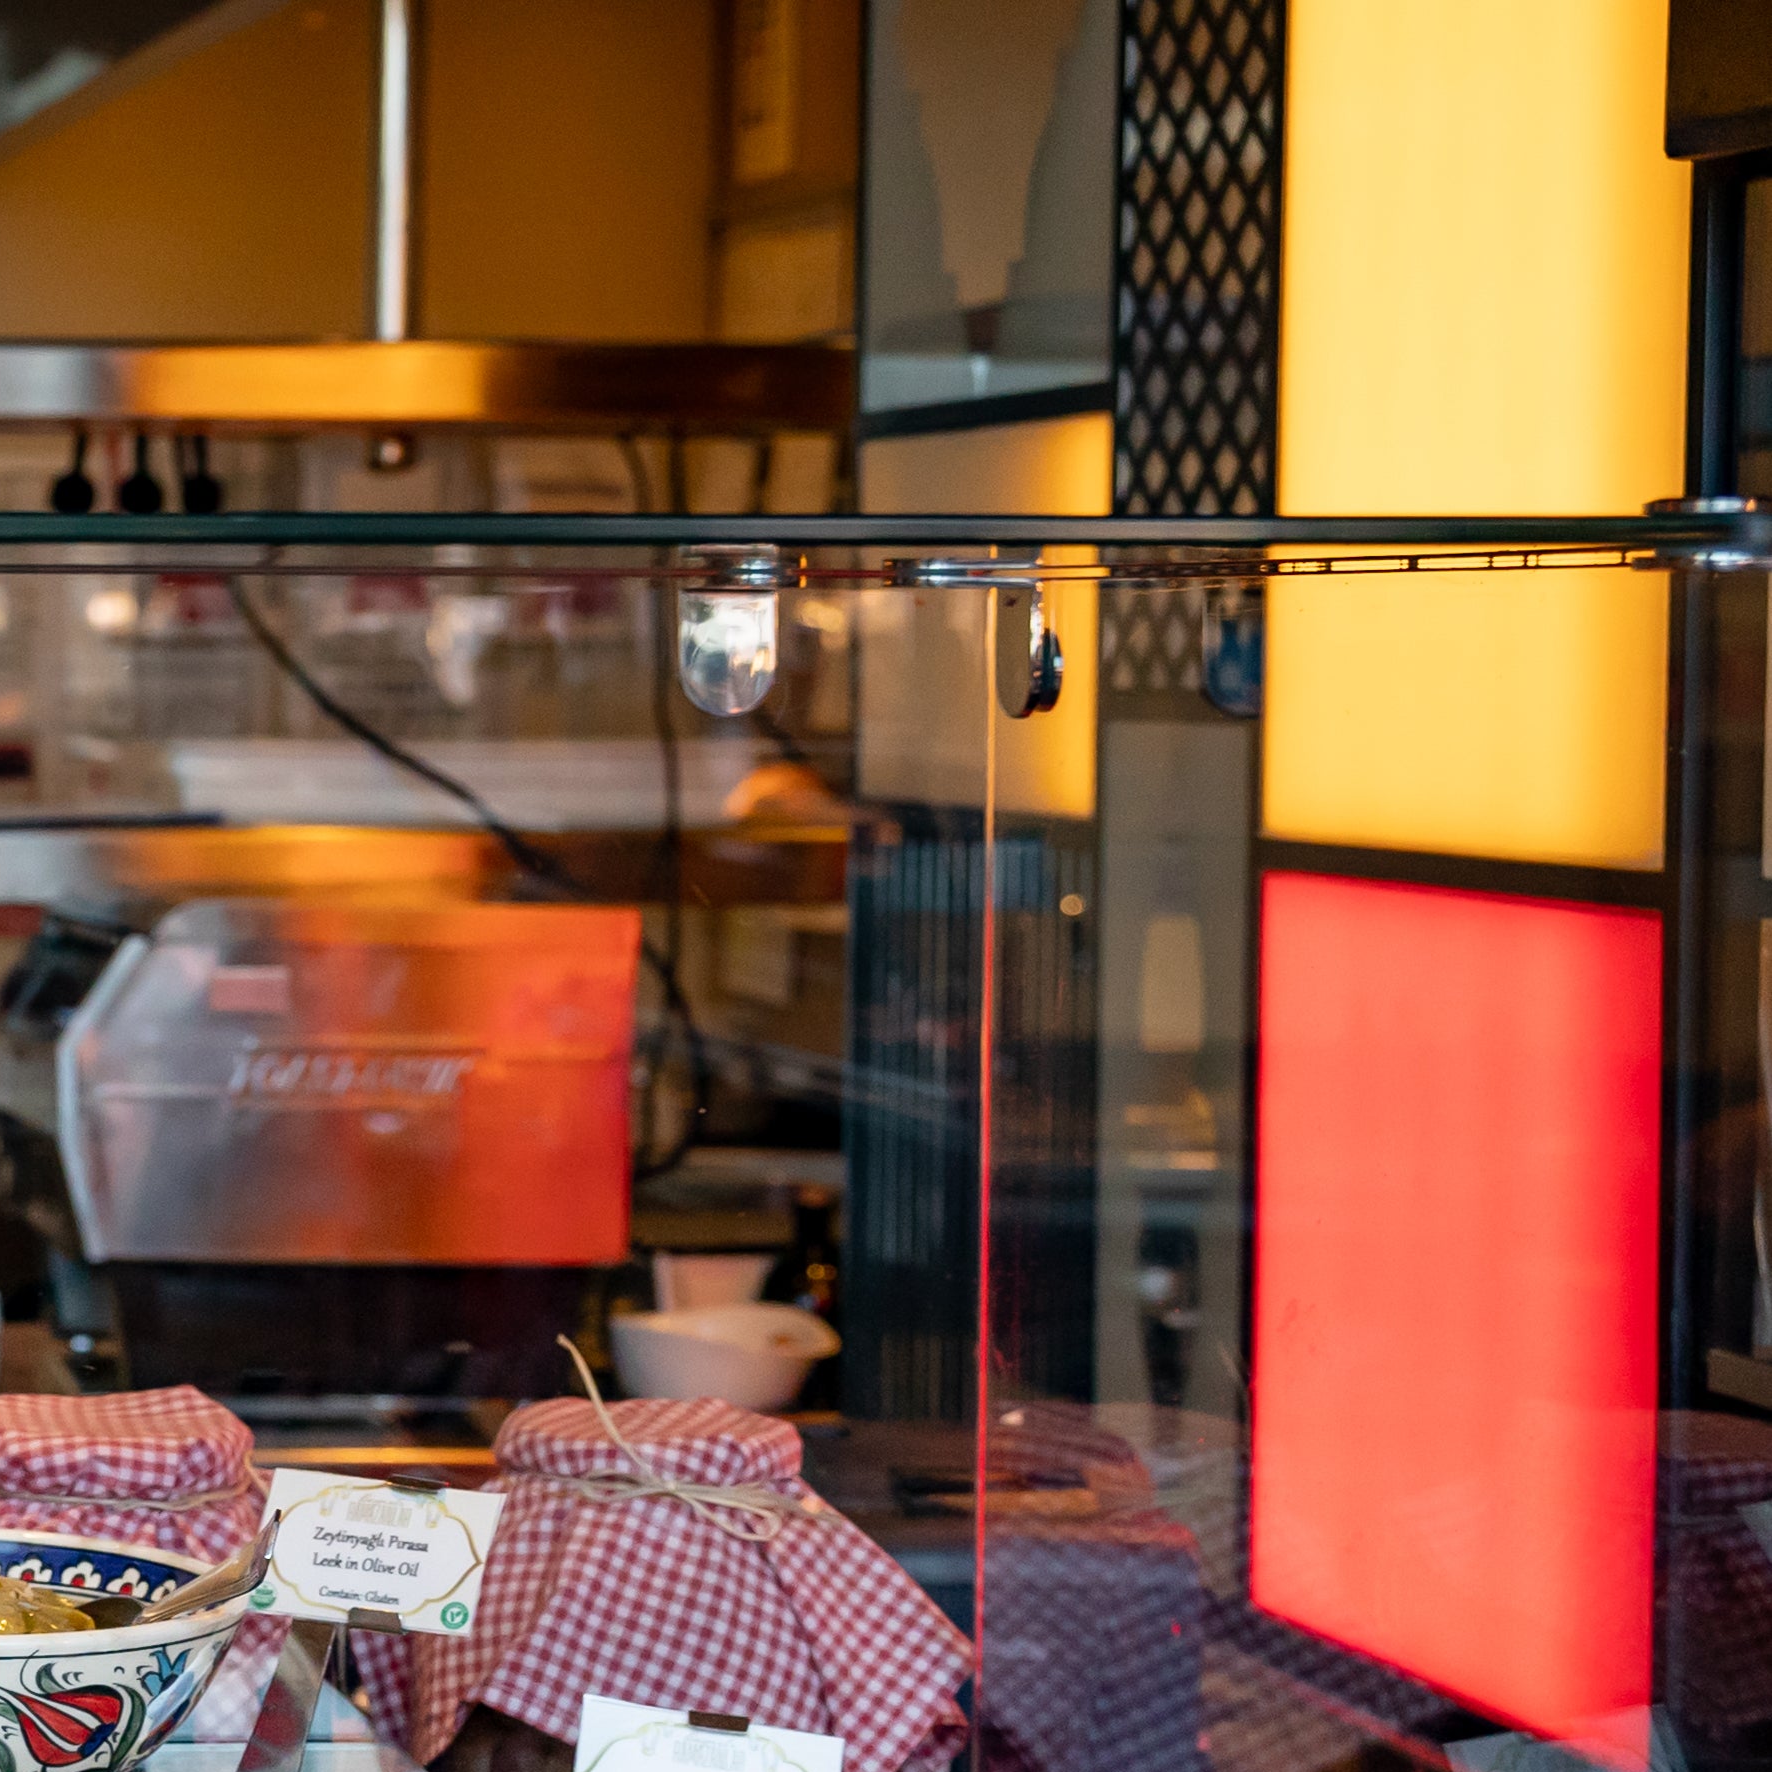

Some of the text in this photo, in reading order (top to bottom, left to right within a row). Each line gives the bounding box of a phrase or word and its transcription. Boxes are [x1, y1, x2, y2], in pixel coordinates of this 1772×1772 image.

[313, 1527, 384, 1552] Zeytinyağlı
[313, 1553, 420, 1577] Leek in Olive Oil
